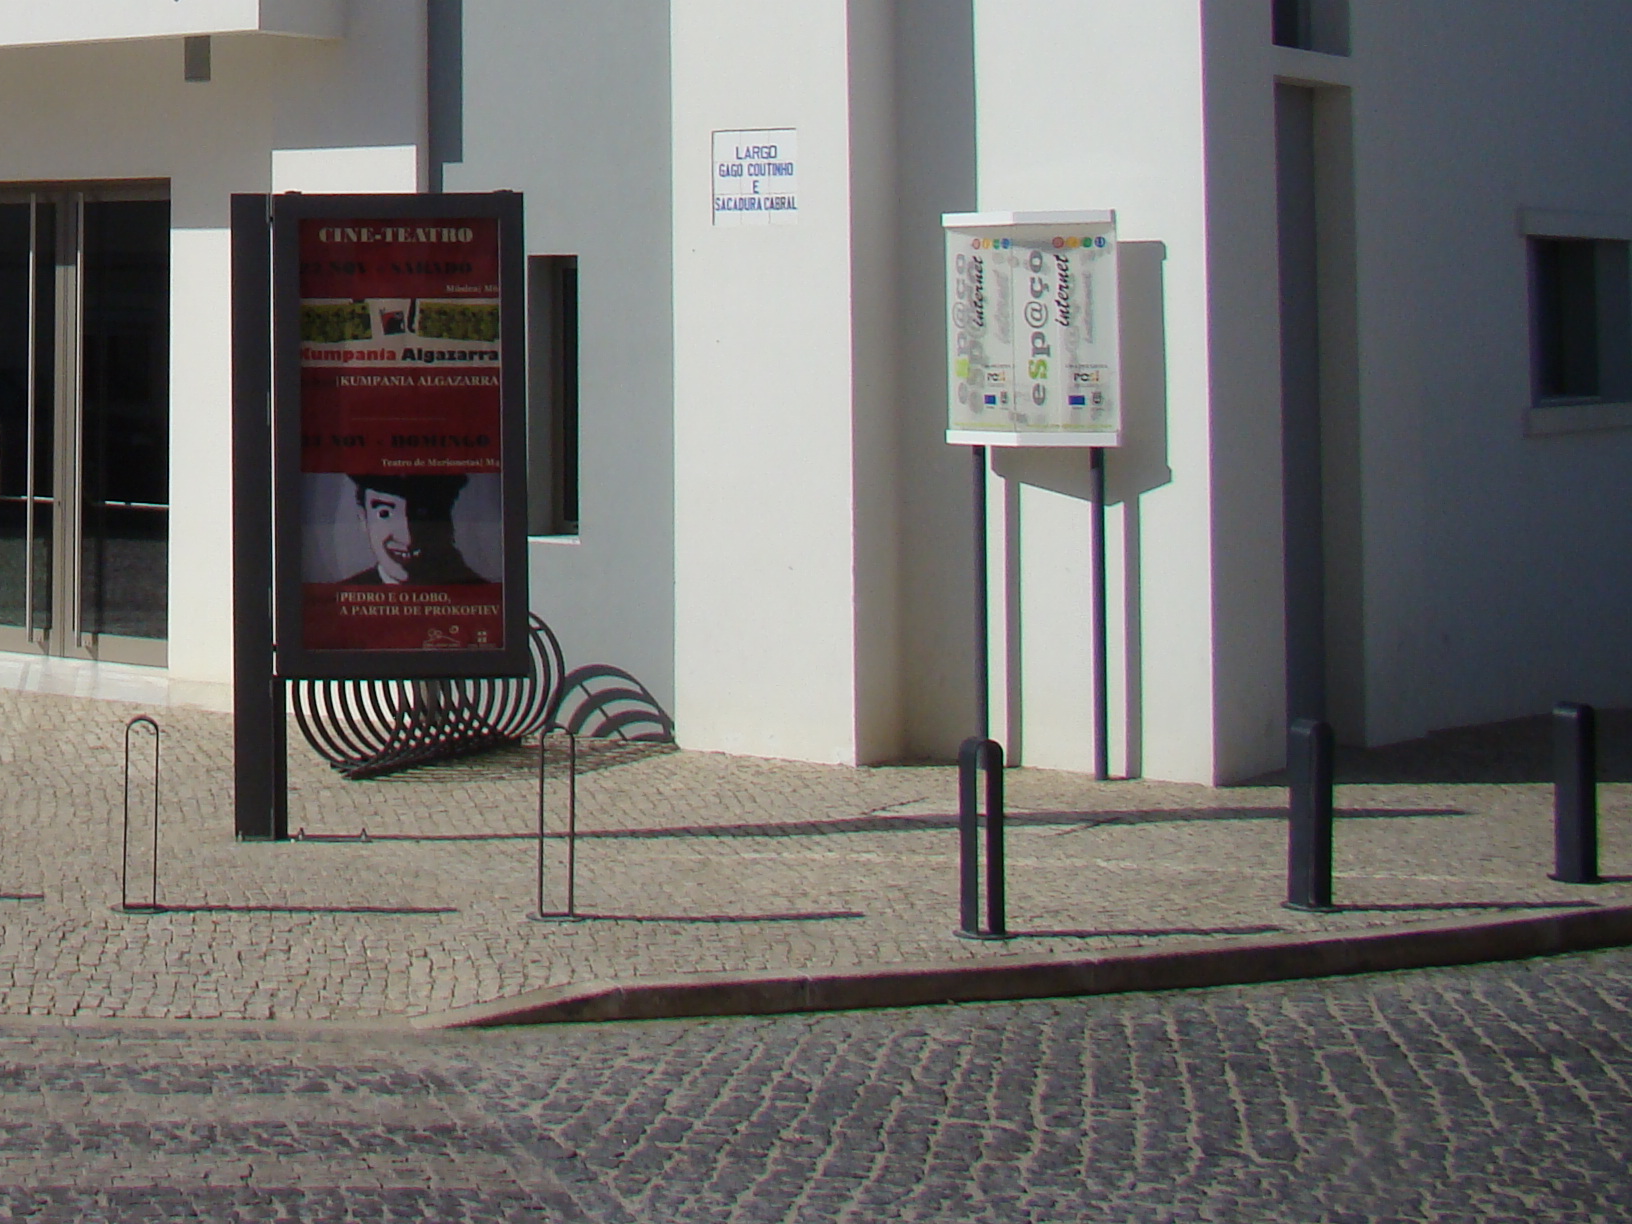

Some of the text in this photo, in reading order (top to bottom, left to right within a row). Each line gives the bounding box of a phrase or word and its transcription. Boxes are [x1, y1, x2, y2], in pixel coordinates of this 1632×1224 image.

[735, 145, 777, 160] LARGO
[718, 162, 794, 177] GAGO COUTINHO
[752, 180, 760, 194] E
[714, 195, 798, 211] SACADURA CABRAL
[318, 226, 474, 243] CINE-TEATRO
[971, 255, 985, 328] internet
[1053, 253, 1070, 327] internet
[401, 347, 500, 363] Algazarra
[417, 375, 500, 388] ALGAZARRA
[381, 458, 412, 467] Teatro
[413, 458, 426, 467] de
[388, 592, 397, 603] E
[399, 592, 410, 603] O
[339, 605, 500, 616] A PARTIR DE PROKOFIEV
